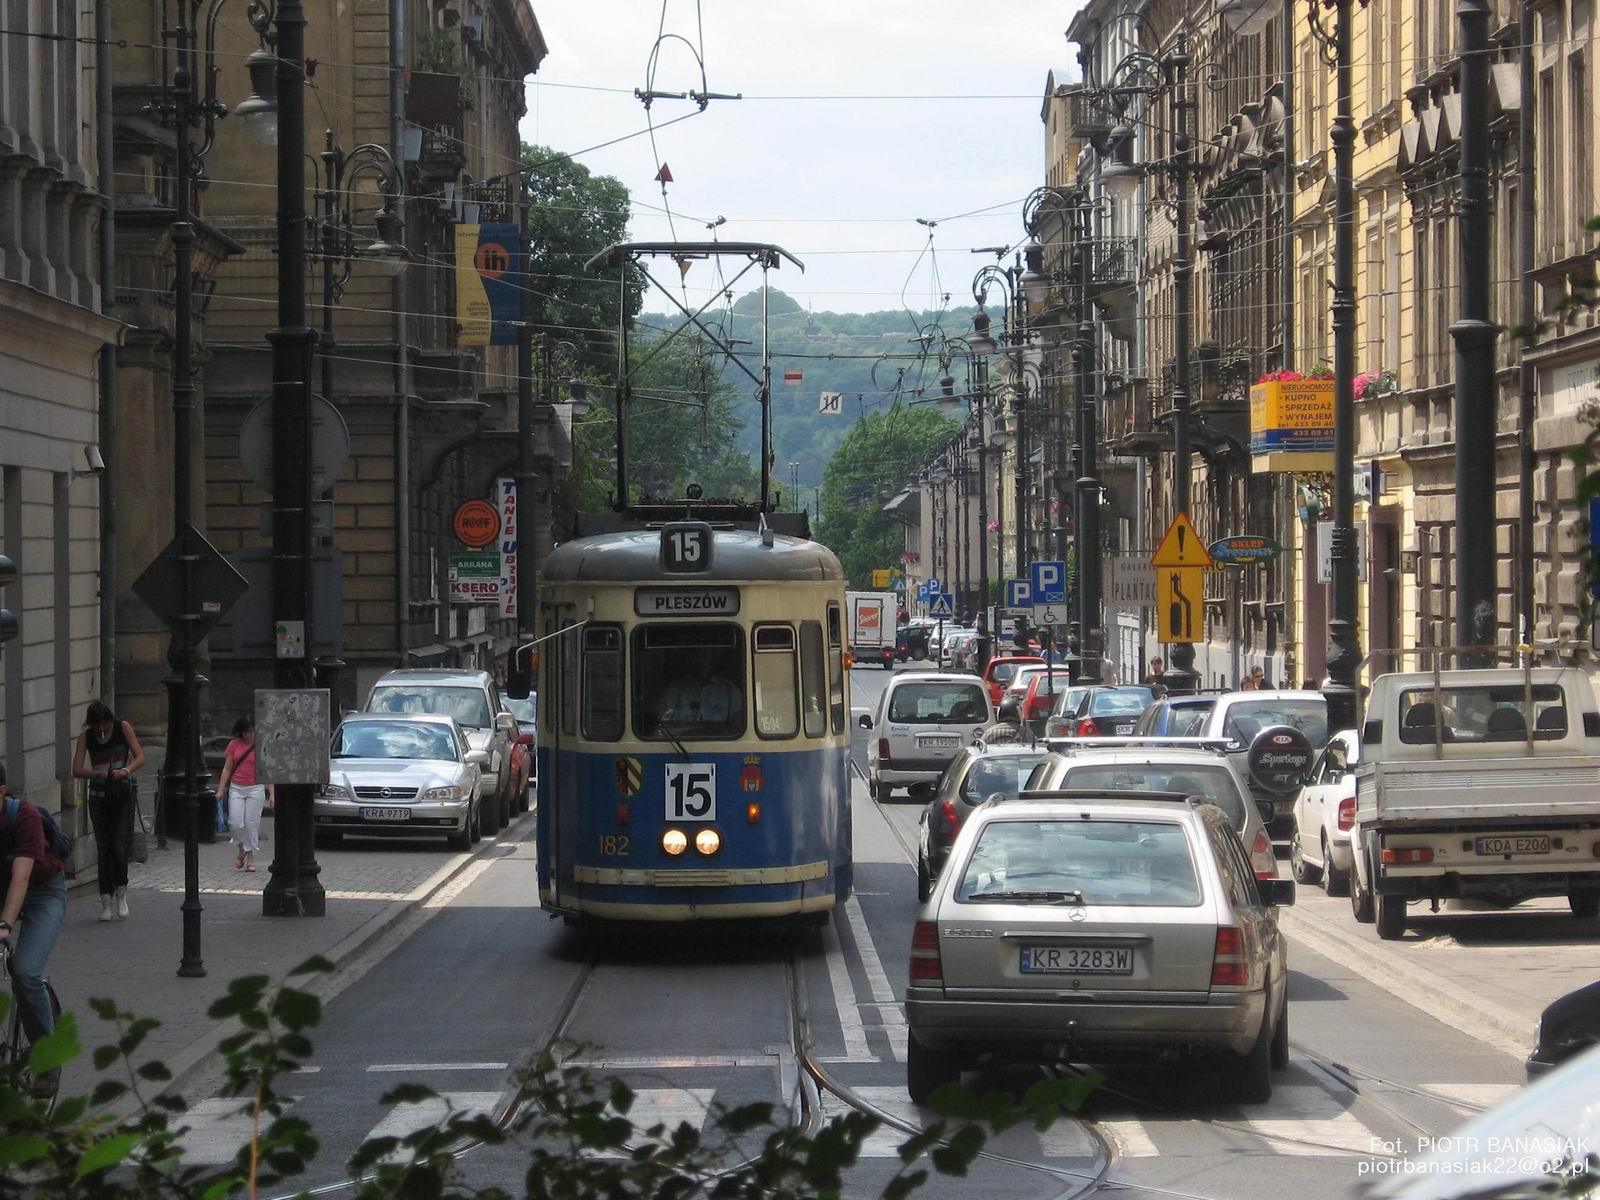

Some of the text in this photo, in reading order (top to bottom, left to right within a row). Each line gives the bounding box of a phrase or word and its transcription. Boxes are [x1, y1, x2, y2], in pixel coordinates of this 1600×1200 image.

[1281, 383, 1335, 391] NIERUCHOMOŚC
[823, 395, 839, 411] 10
[1285, 403, 1332, 411] SPRZEDAŻ
[502, 481, 517, 535] TANIE
[670, 532, 701, 562] 15
[1231, 540, 1265, 549] SKLEP
[458, 560, 493, 569] ARKANA
[1039, 565, 1058, 592] P
[451, 582, 499, 594] KSERO
[1013, 582, 1030, 605] P
[1114, 582, 1156, 601] PLANTAC
[655, 593, 727, 610] PLESZÓW
[1259, 753, 1308, 768] Sportage
[670, 773, 712, 817] 15
[365, 809, 384, 818] KRA
[600, 835, 630, 856] 182
[1485, 838, 1547, 852] KDA E206
[1033, 949, 1129, 968] KR 3283W
